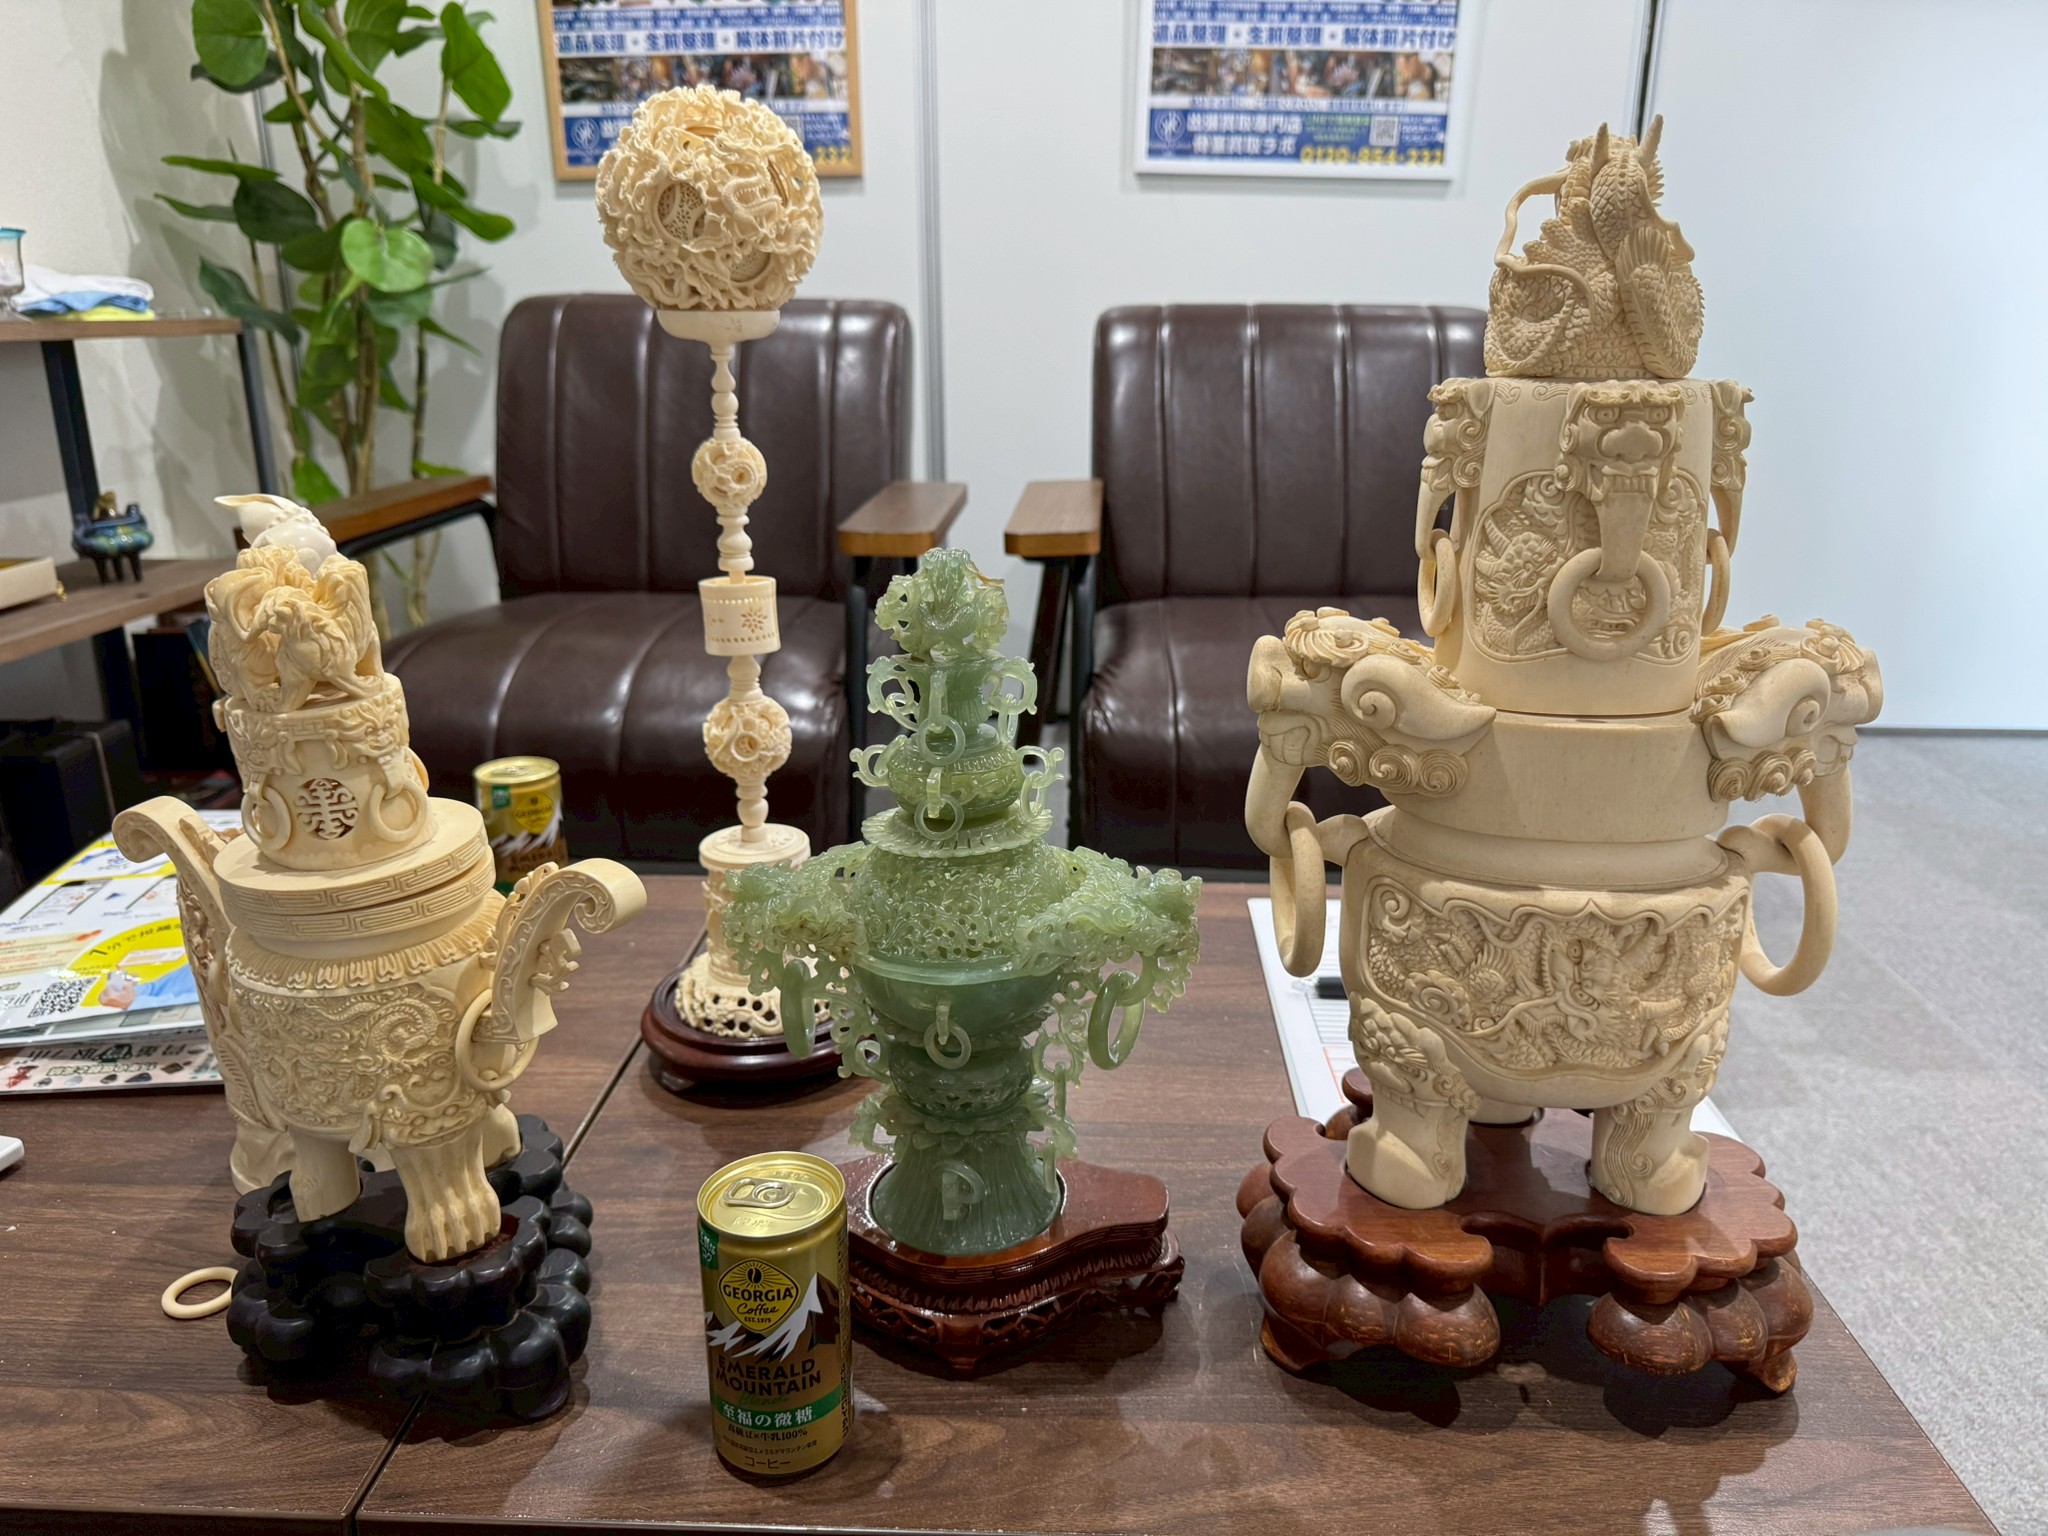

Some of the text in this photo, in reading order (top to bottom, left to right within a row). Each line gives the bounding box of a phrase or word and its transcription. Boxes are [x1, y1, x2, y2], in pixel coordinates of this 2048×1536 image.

[722, 1284, 795, 1303] GEORGIA
[736, 1302, 780, 1316] Coffee
[757, 1316, 772, 1324] 1975
[718, 1353, 816, 1381] EMERALD
[716, 1369, 821, 1397] MOUNTAIN
[722, 1404, 814, 1429] 至福の微糖
[744, 1455, 792, 1470] コーヒー
